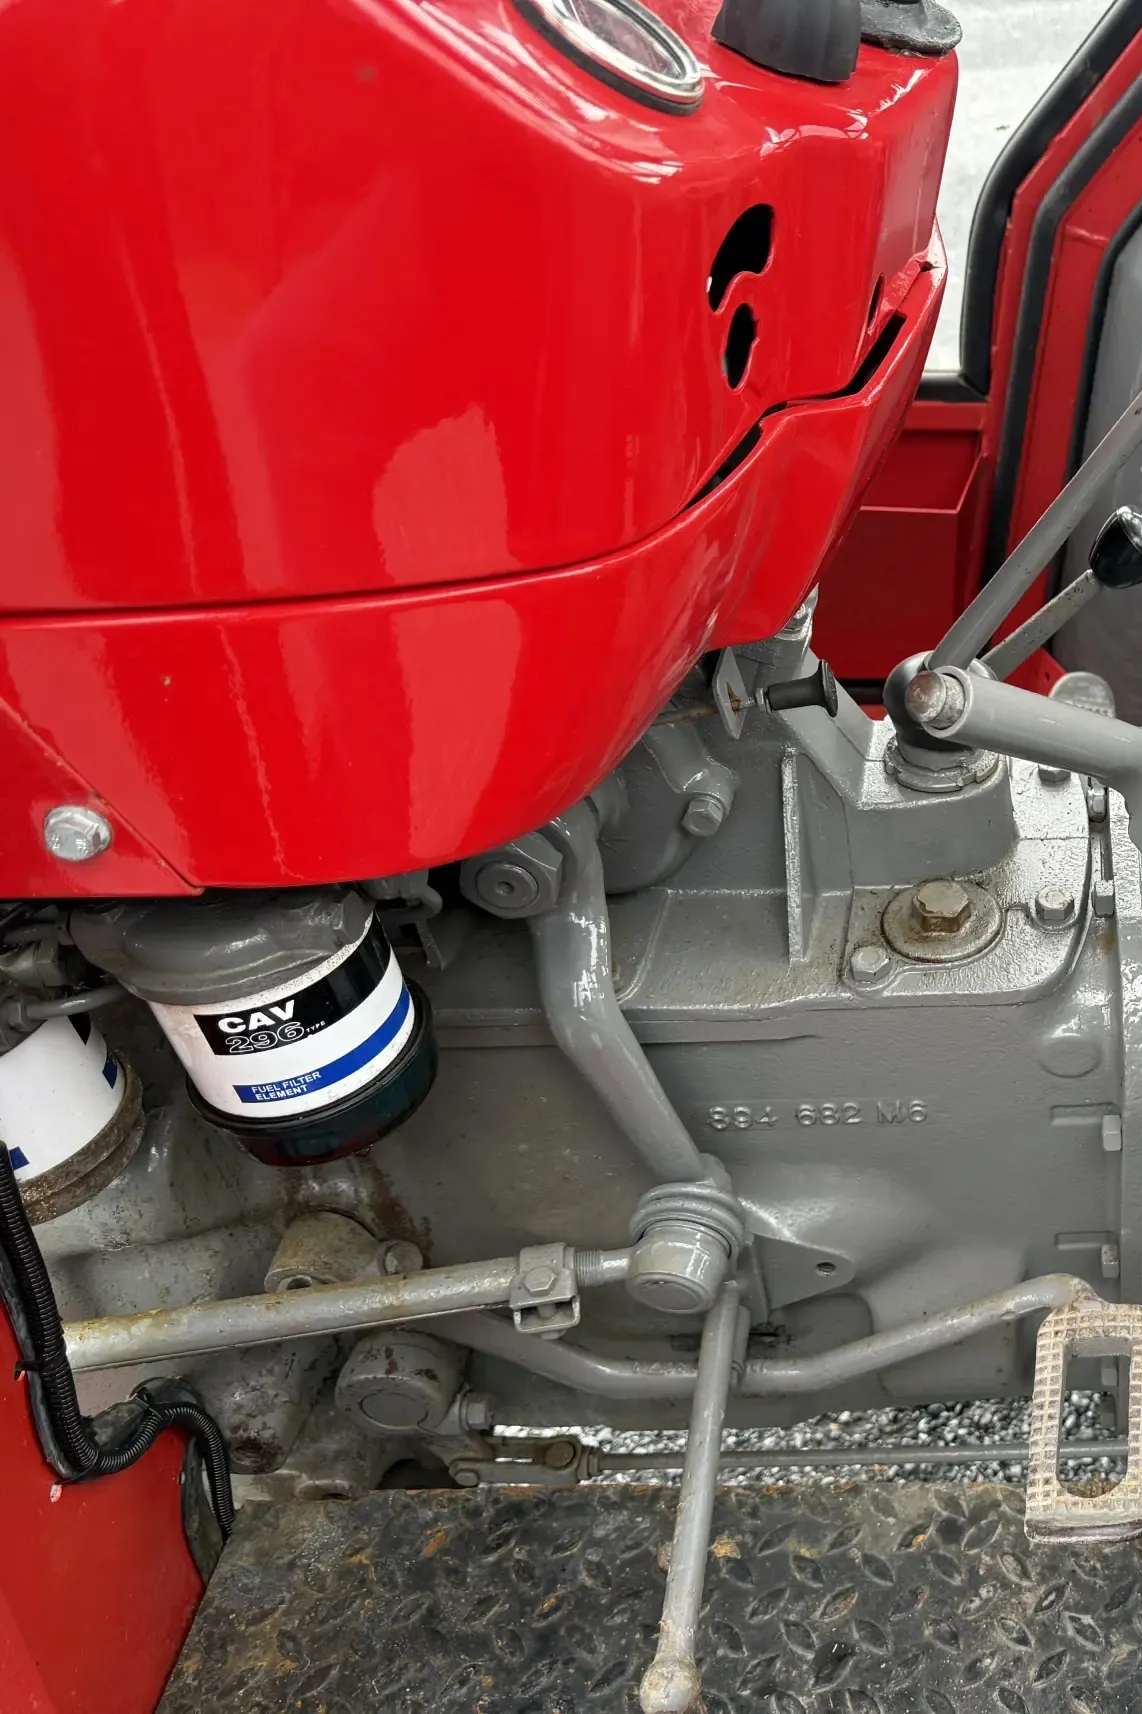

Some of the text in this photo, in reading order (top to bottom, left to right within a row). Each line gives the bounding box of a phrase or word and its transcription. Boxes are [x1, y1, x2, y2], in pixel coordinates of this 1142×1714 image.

[217, 999, 295, 1034] CAV
[225, 1020, 326, 1053] 296 TYPE
[251, 1071, 321, 1094] FUEL FILTER
[255, 1084, 308, 1101] ELEMENT
[797, 1102, 863, 1126] 682
[876, 1099, 929, 1125] M6
